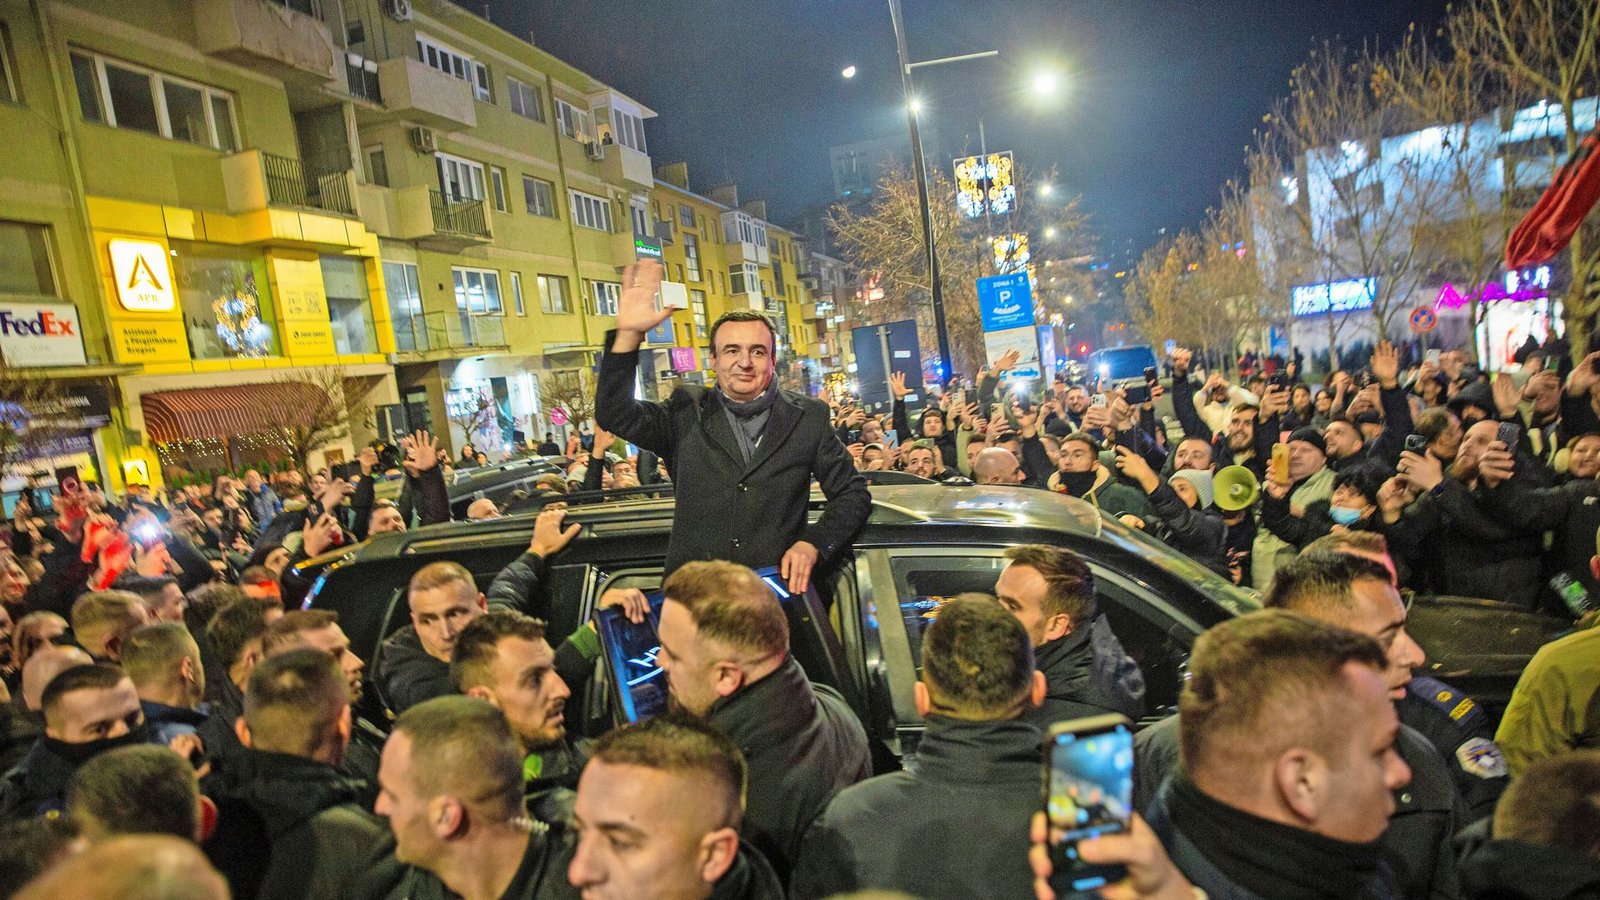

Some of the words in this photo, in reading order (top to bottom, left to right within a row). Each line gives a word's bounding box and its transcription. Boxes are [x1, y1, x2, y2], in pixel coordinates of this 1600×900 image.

[993, 280, 1009, 288] ZONA
[1000, 290, 1011, 303] P
[0, 310, 76, 336] FedEx
